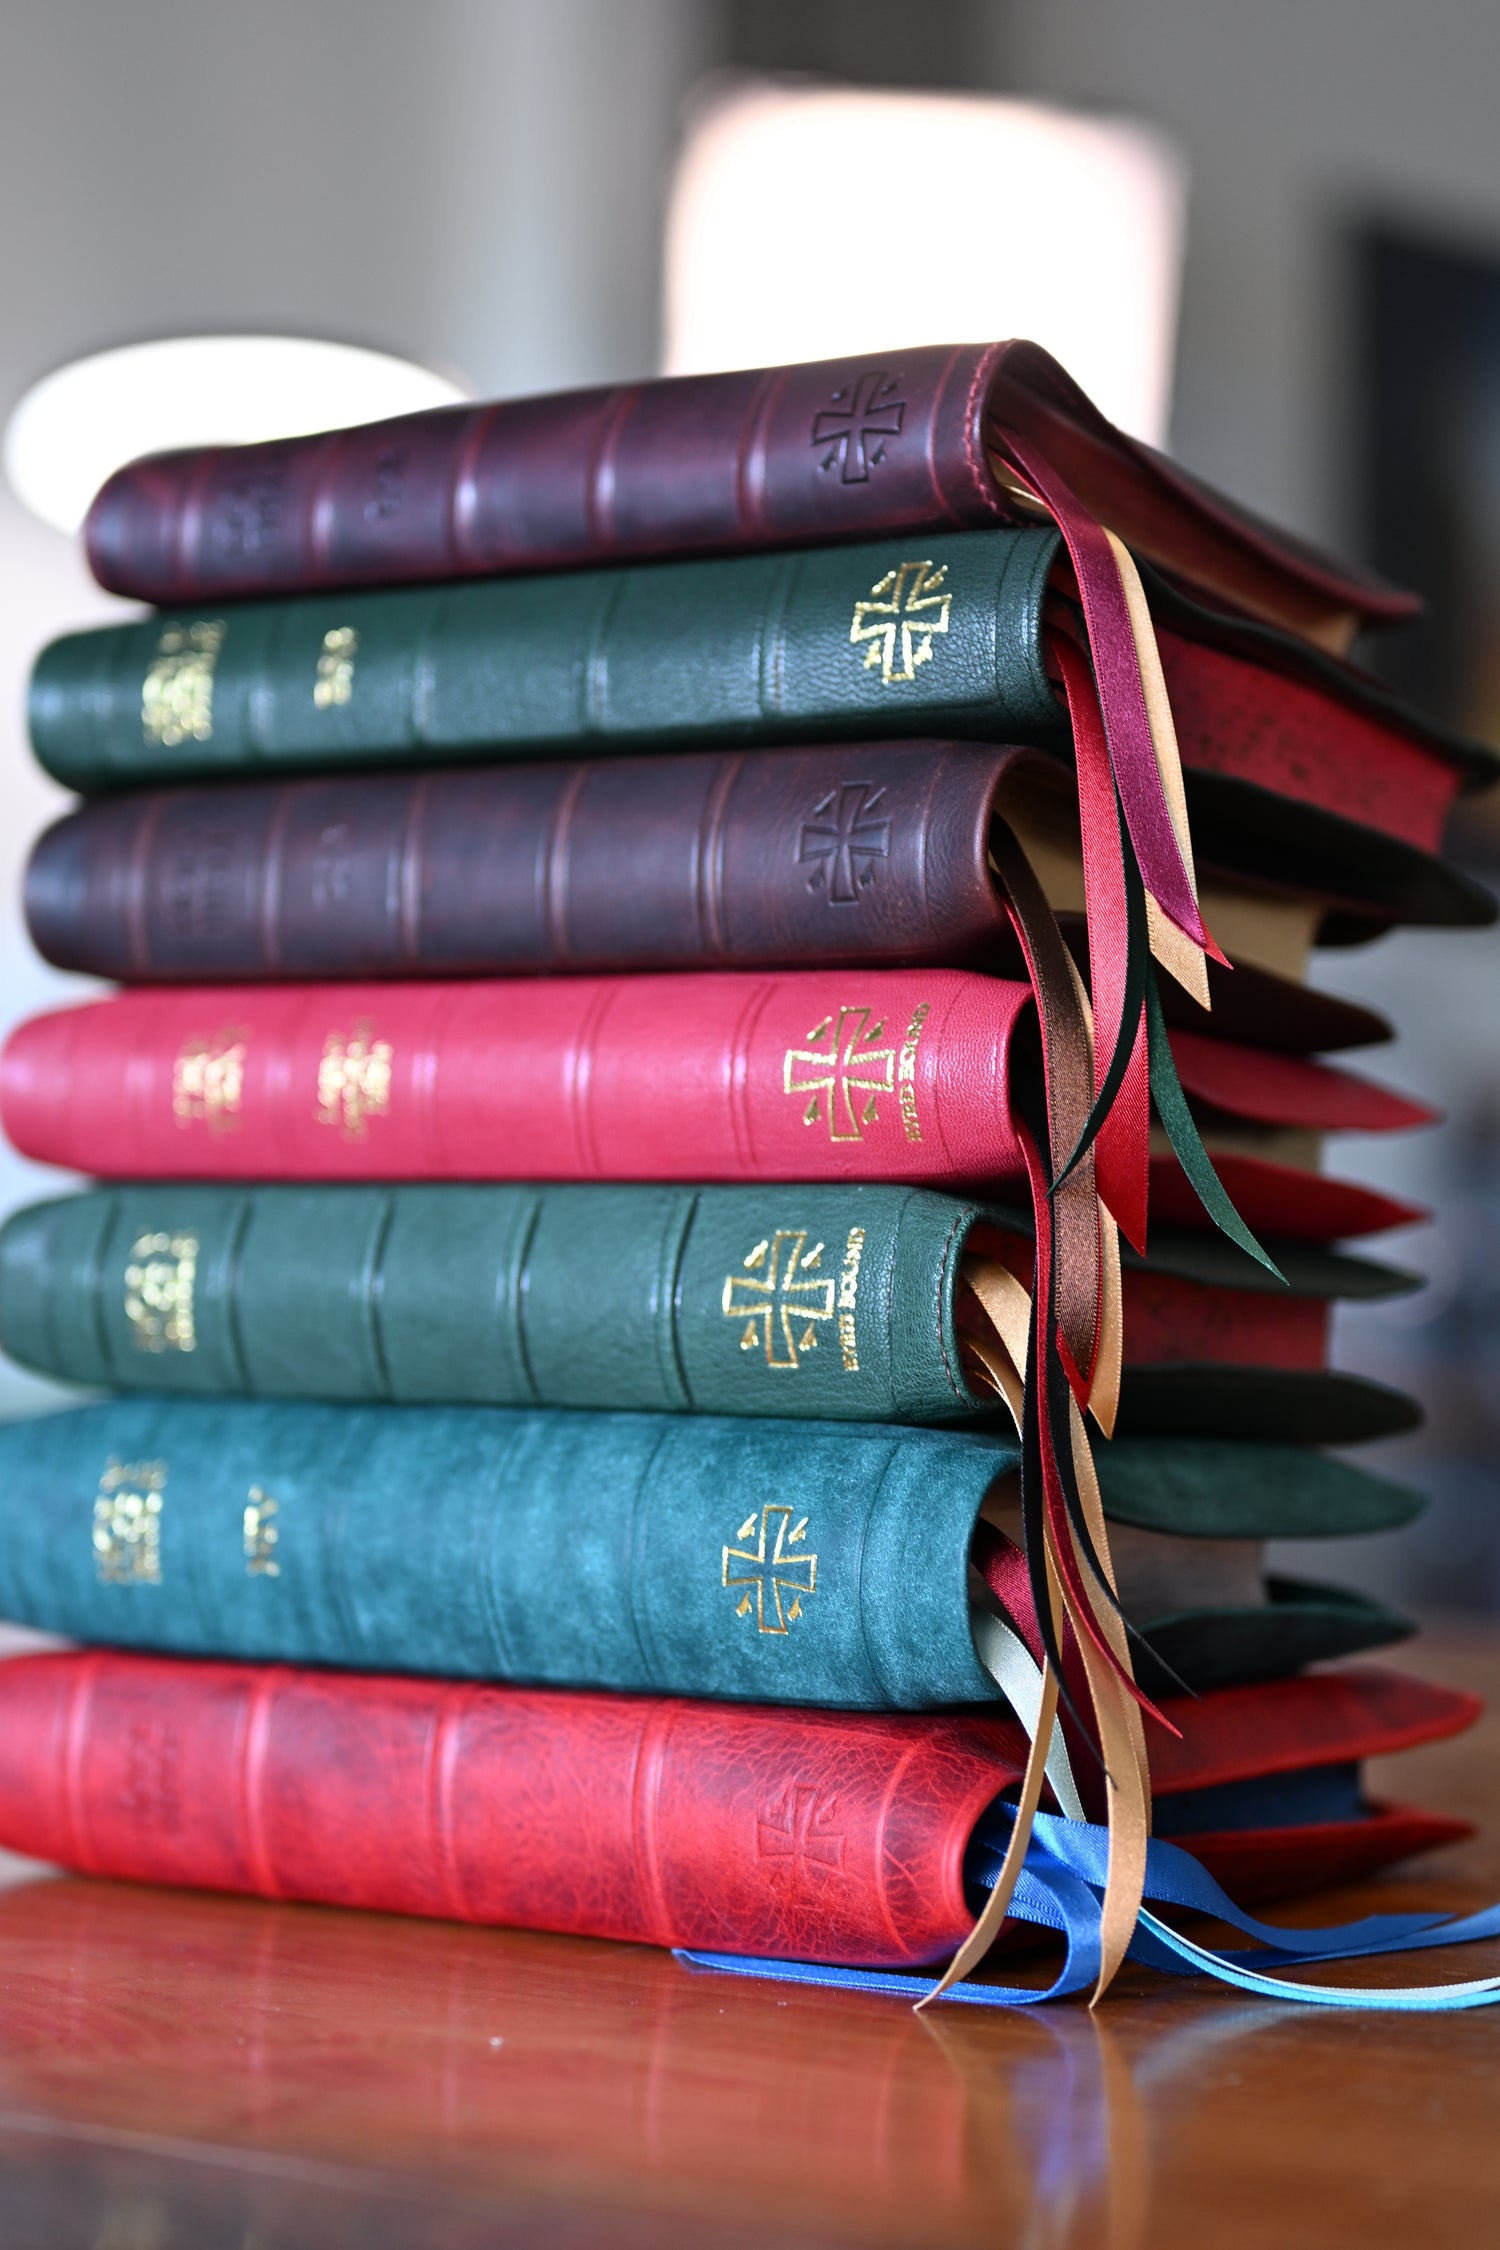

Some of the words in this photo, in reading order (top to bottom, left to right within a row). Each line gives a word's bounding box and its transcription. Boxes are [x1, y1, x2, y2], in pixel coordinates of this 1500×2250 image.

[898, 1001, 931, 1082] BOUND
[899, 1084, 922, 1142] BYRD
[838, 1227, 865, 1309] BOUND
[839, 1314, 859, 1371] BYRD
